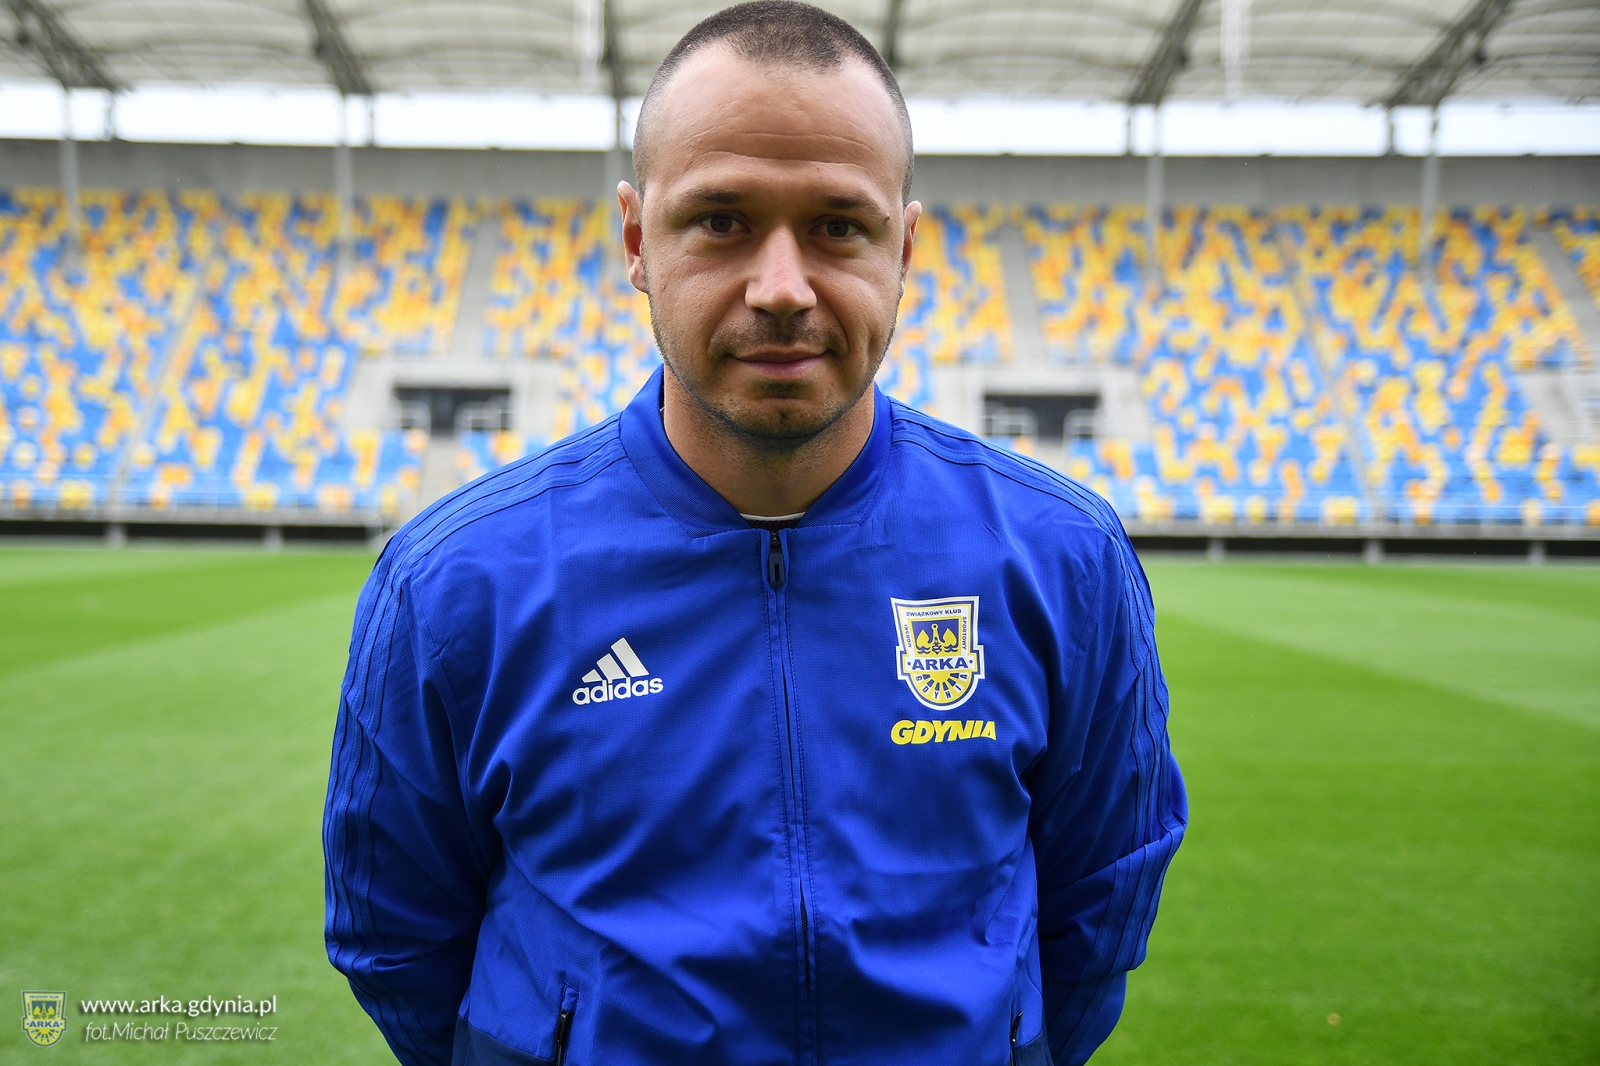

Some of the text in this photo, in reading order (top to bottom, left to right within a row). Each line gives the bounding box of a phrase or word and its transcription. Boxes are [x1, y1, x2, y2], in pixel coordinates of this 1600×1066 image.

[911, 657, 969, 671] ARKA
[572, 677, 664, 705] adidas
[915, 673, 968, 699] GDYNIA
[890, 719, 997, 745] GDYNIA
